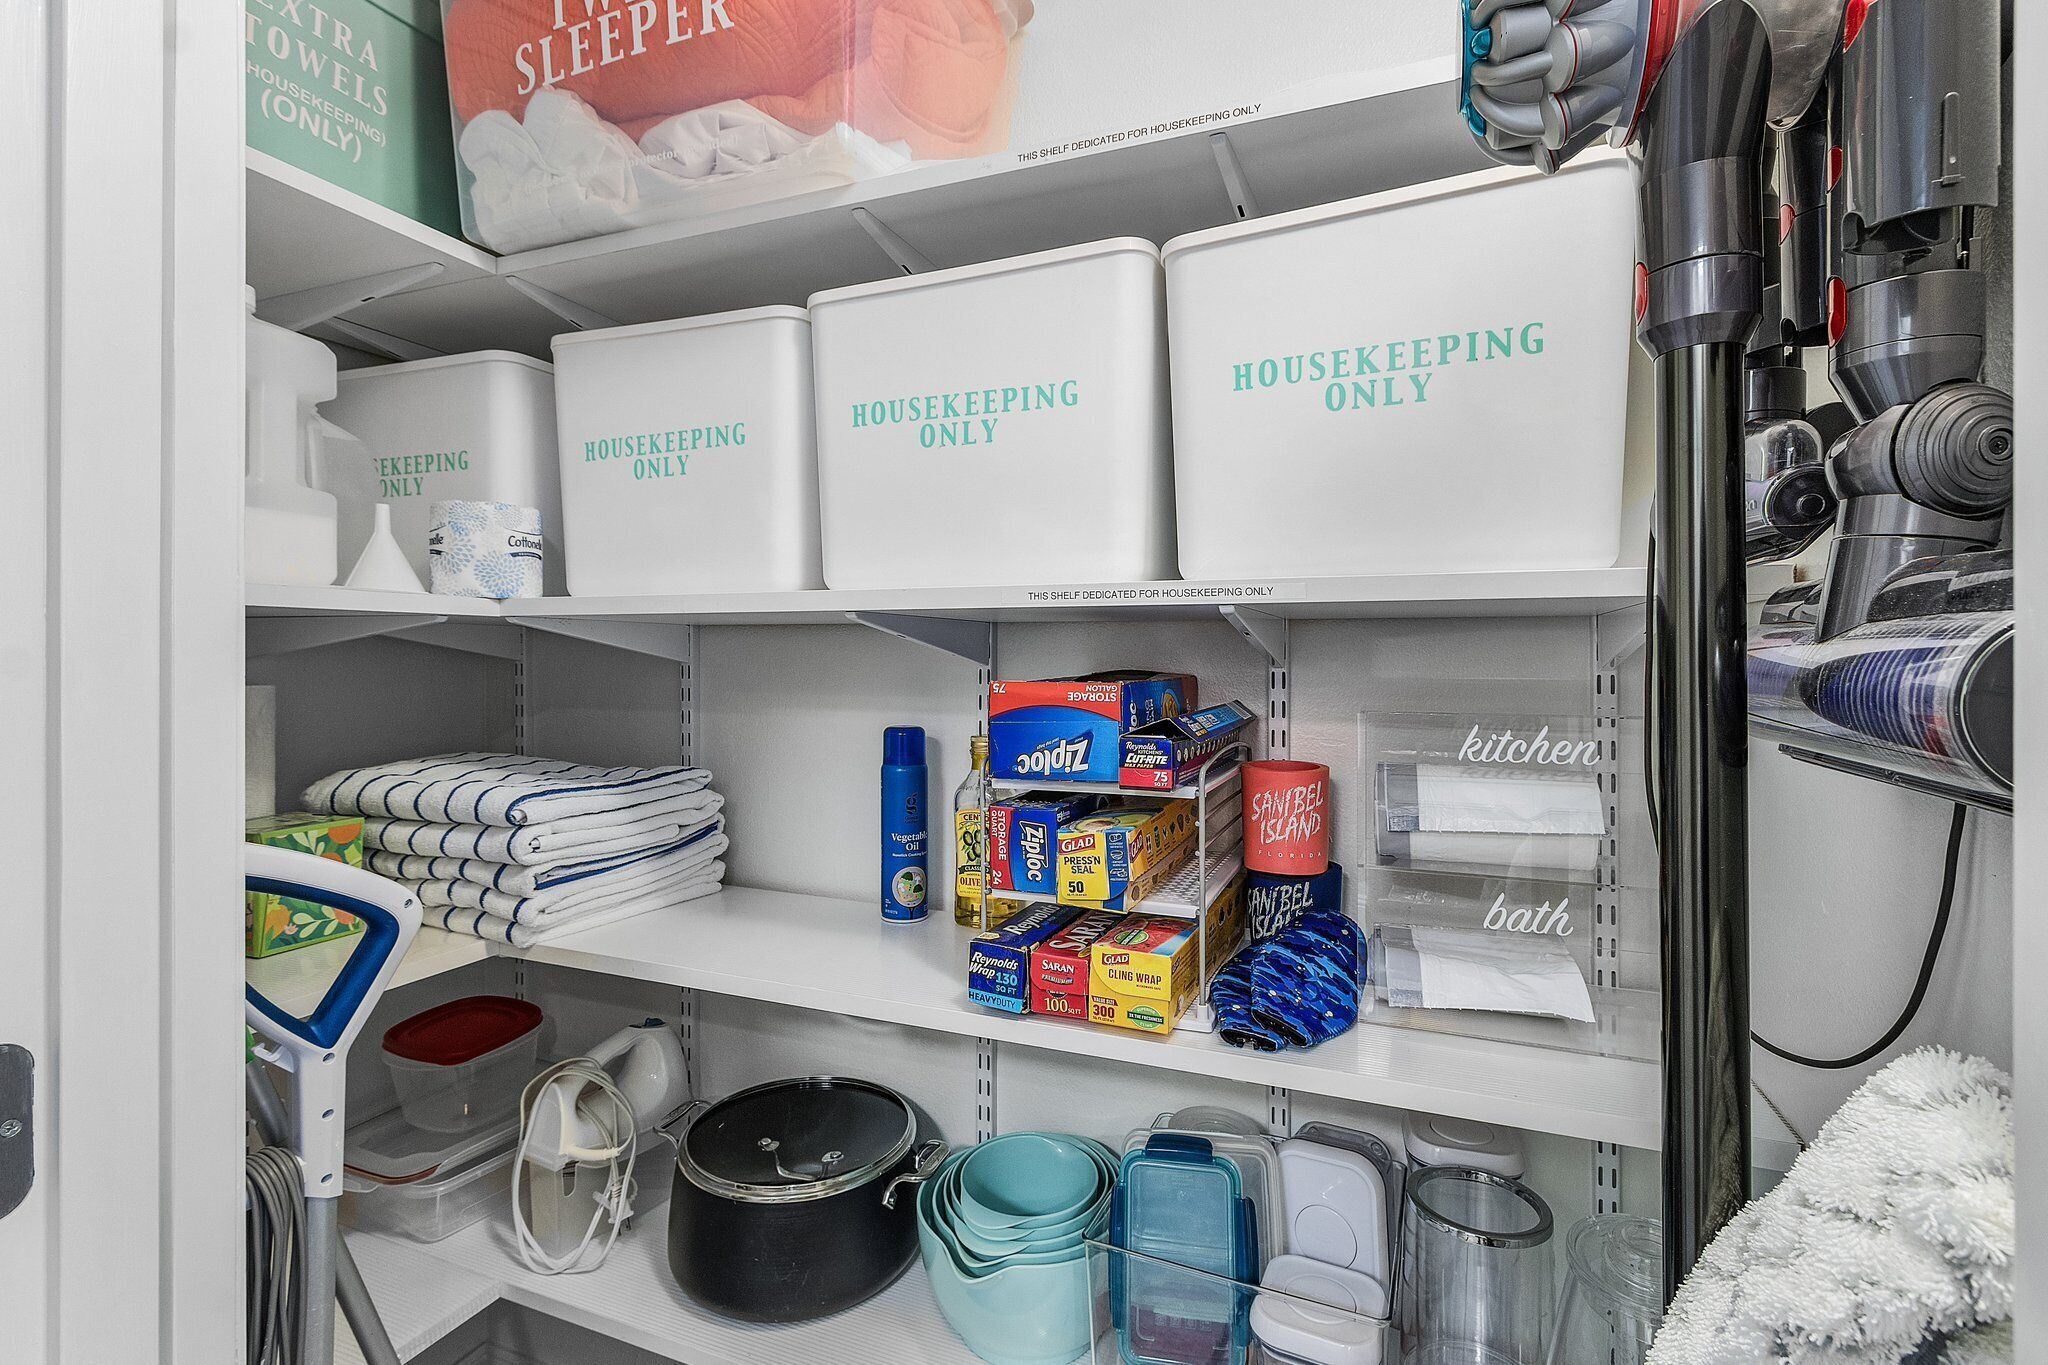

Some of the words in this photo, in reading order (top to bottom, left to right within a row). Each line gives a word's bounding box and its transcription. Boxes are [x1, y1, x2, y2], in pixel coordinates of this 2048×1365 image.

[515, 0, 735, 96] SLEEPER
[245, 12, 388, 116] TOWELS
[261, 88, 362, 164] (ONLY)
[1017, 150, 1038, 163] THIS
[1039, 143, 1070, 158] SHELF
[1071, 131, 1126, 152] DEDICATED
[1127, 127, 1148, 139] FOR
[1150, 109, 1230, 134] HOUSEKEEPING
[1232, 103, 1262, 117] ONLY
[1232, 322, 1546, 392] HOUSEKEEPING
[1324, 372, 1434, 412] ONLY
[851, 380, 1080, 428] HOUSEKEEPING
[919, 417, 999, 448] ONLY
[584, 422, 746, 462] HOUSEKEEPING
[633, 454, 690, 480] ONLY
[1028, 591, 1048, 600] THIS
[1050, 591, 1080, 600] SHELF
[1082, 589, 1137, 600] DEDICATED
[1139, 589, 1160, 599] FOR
[1162, 587, 1243, 598] HOUSEKEEPING
[1245, 586, 1274, 596] ONLY
[993, 684, 1006, 693] 75
[1067, 692, 1117, 702] STORAGE
[1125, 741, 1156, 751] Reynolds
[1458, 723, 1600, 766] kitchen
[1017, 739, 1089, 776] Ziploc
[1126, 753, 1168, 765] CUT-RITE
[1153, 772, 1168, 782] 75
[1252, 781, 1324, 822] SANIBEL
[997, 810, 1007, 860] STORAGE
[1260, 812, 1321, 845] ISLAND
[905, 842, 919, 851] Oil
[1061, 836, 1094, 852] GLAD
[1020, 827, 1045, 881] Ziploc
[1258, 850, 1322, 859] FLORIDA
[992, 869, 1002, 885] 24
[1071, 865, 1094, 874] SEAL
[1068, 880, 1084, 893] 50
[1483, 892, 1574, 936] bath
[971, 951, 1019, 970] Reynolds
[1042, 959, 1075, 974] SARAN
[1104, 954, 1129, 964] GLAD
[969, 961, 995, 979] Wrap
[1108, 968, 1133, 982] CLING
[1135, 972, 1162, 985] WRAP
[995, 972, 1018, 986] 130
[995, 984, 1006, 993] SQ
[1007, 986, 1017, 995] FT
[1044, 998, 1068, 1012] 100
[1093, 1004, 1115, 1019] 300
